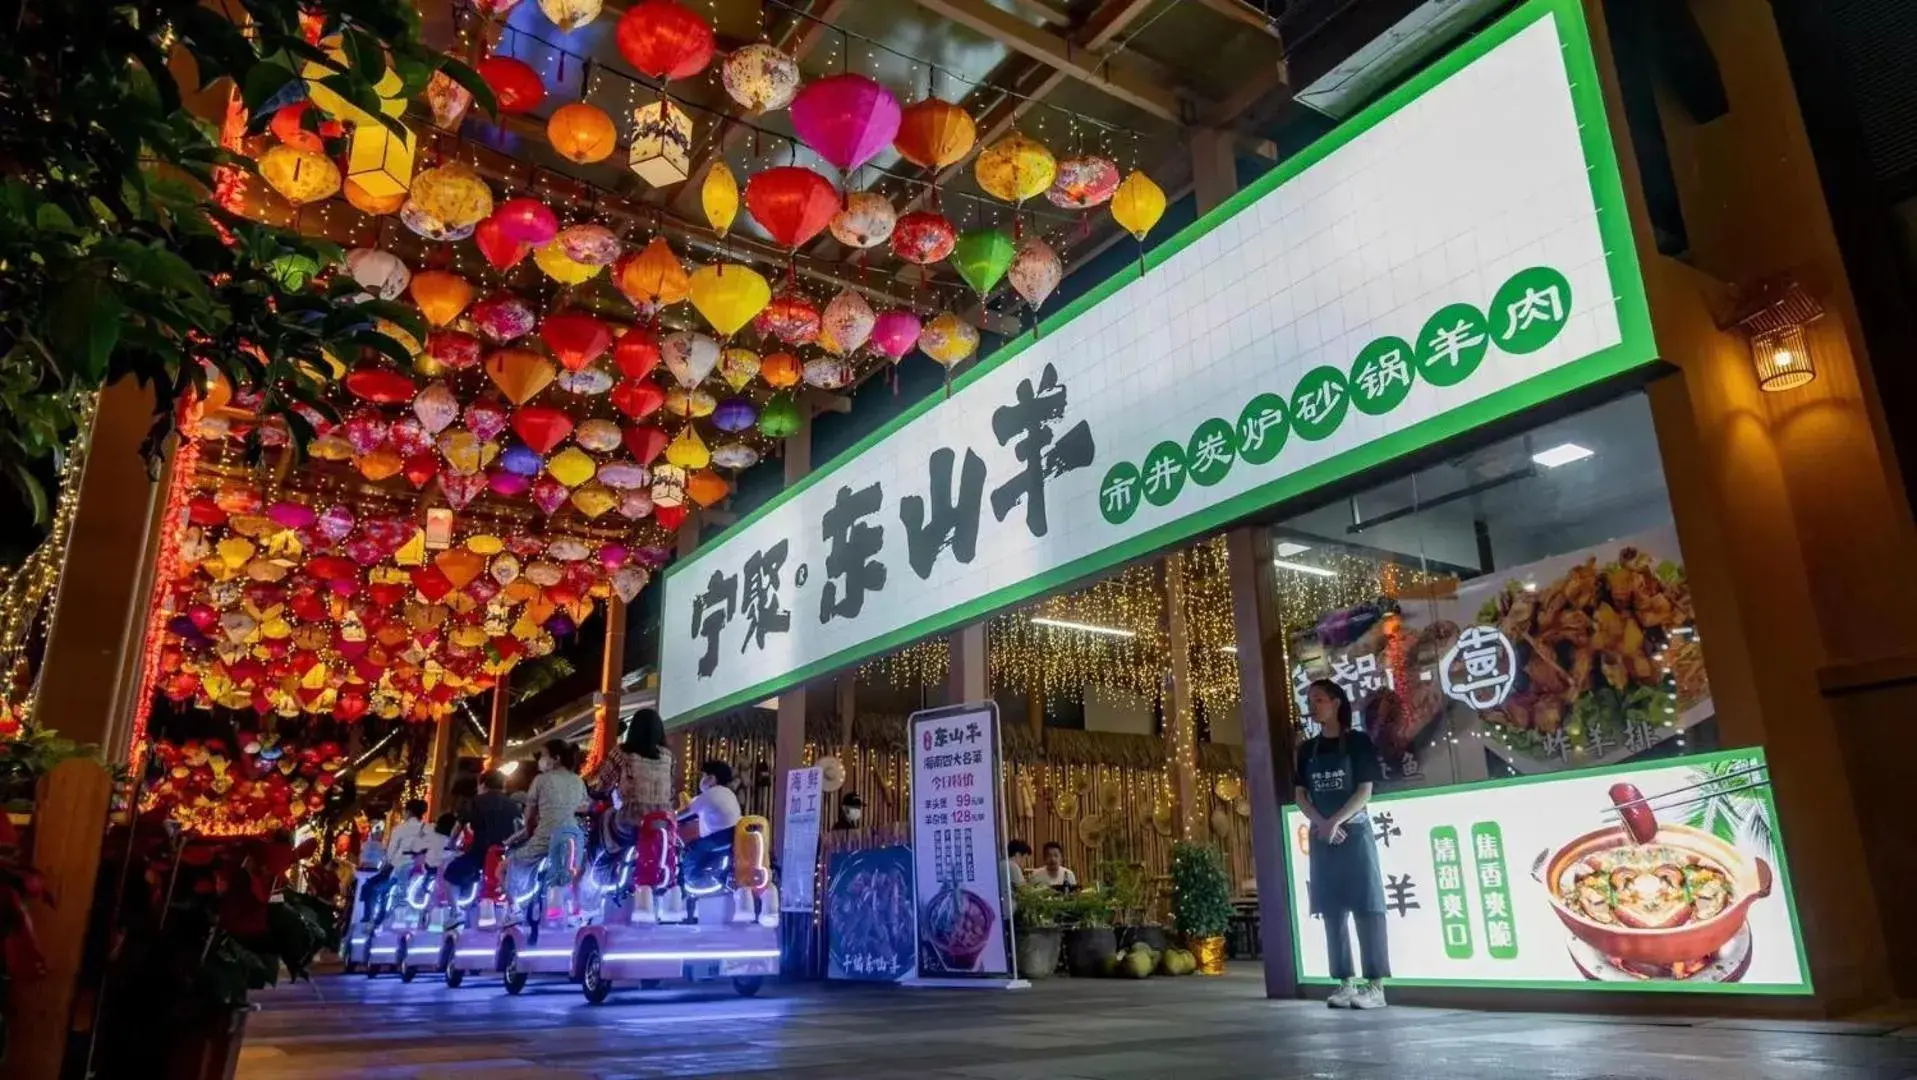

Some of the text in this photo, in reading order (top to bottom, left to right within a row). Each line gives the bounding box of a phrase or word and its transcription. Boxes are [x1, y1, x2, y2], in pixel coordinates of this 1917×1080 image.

[819, 362, 1096, 625] 东山羊
[1102, 284, 1564, 513] 市井炭炉砂锅羊肉
